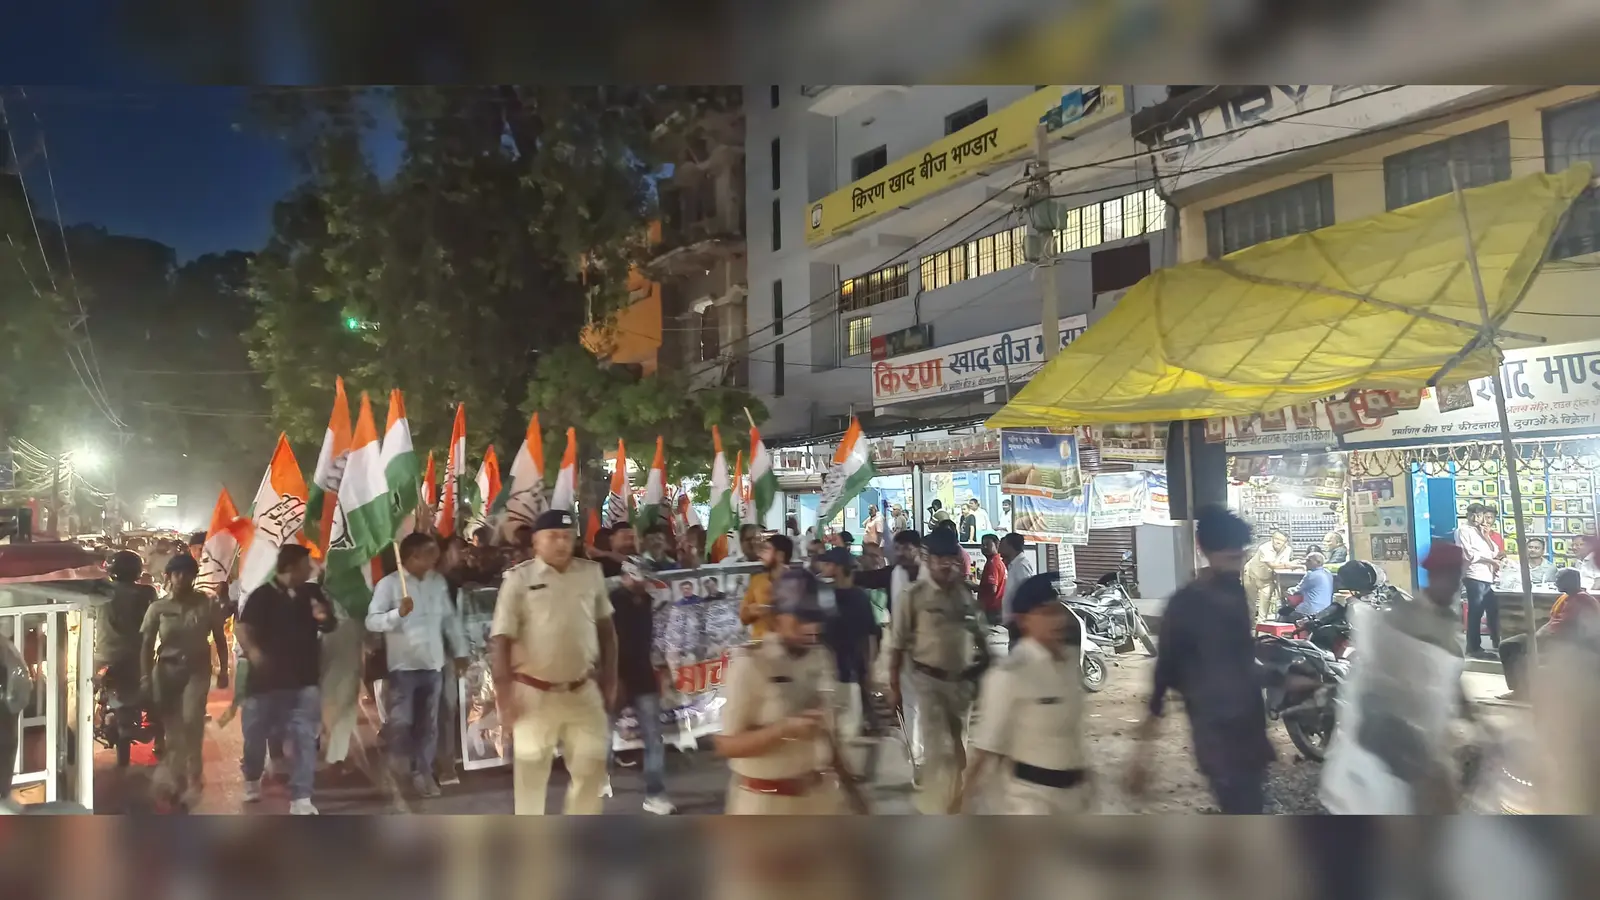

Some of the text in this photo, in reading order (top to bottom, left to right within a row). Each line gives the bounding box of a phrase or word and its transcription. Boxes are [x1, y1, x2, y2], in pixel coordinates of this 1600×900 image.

[851, 181, 885, 213] किरण
[888, 167, 916, 193] खाद
[919, 152, 948, 180] बीज
[951, 128, 999, 166] भण्डार
[874, 358, 944, 397] किरण
[948, 346, 991, 376] खाद
[993, 333, 1033, 366] बीज
[1458, 421, 1501, 431] कीटनाश
[1549, 413, 1559, 425] के
